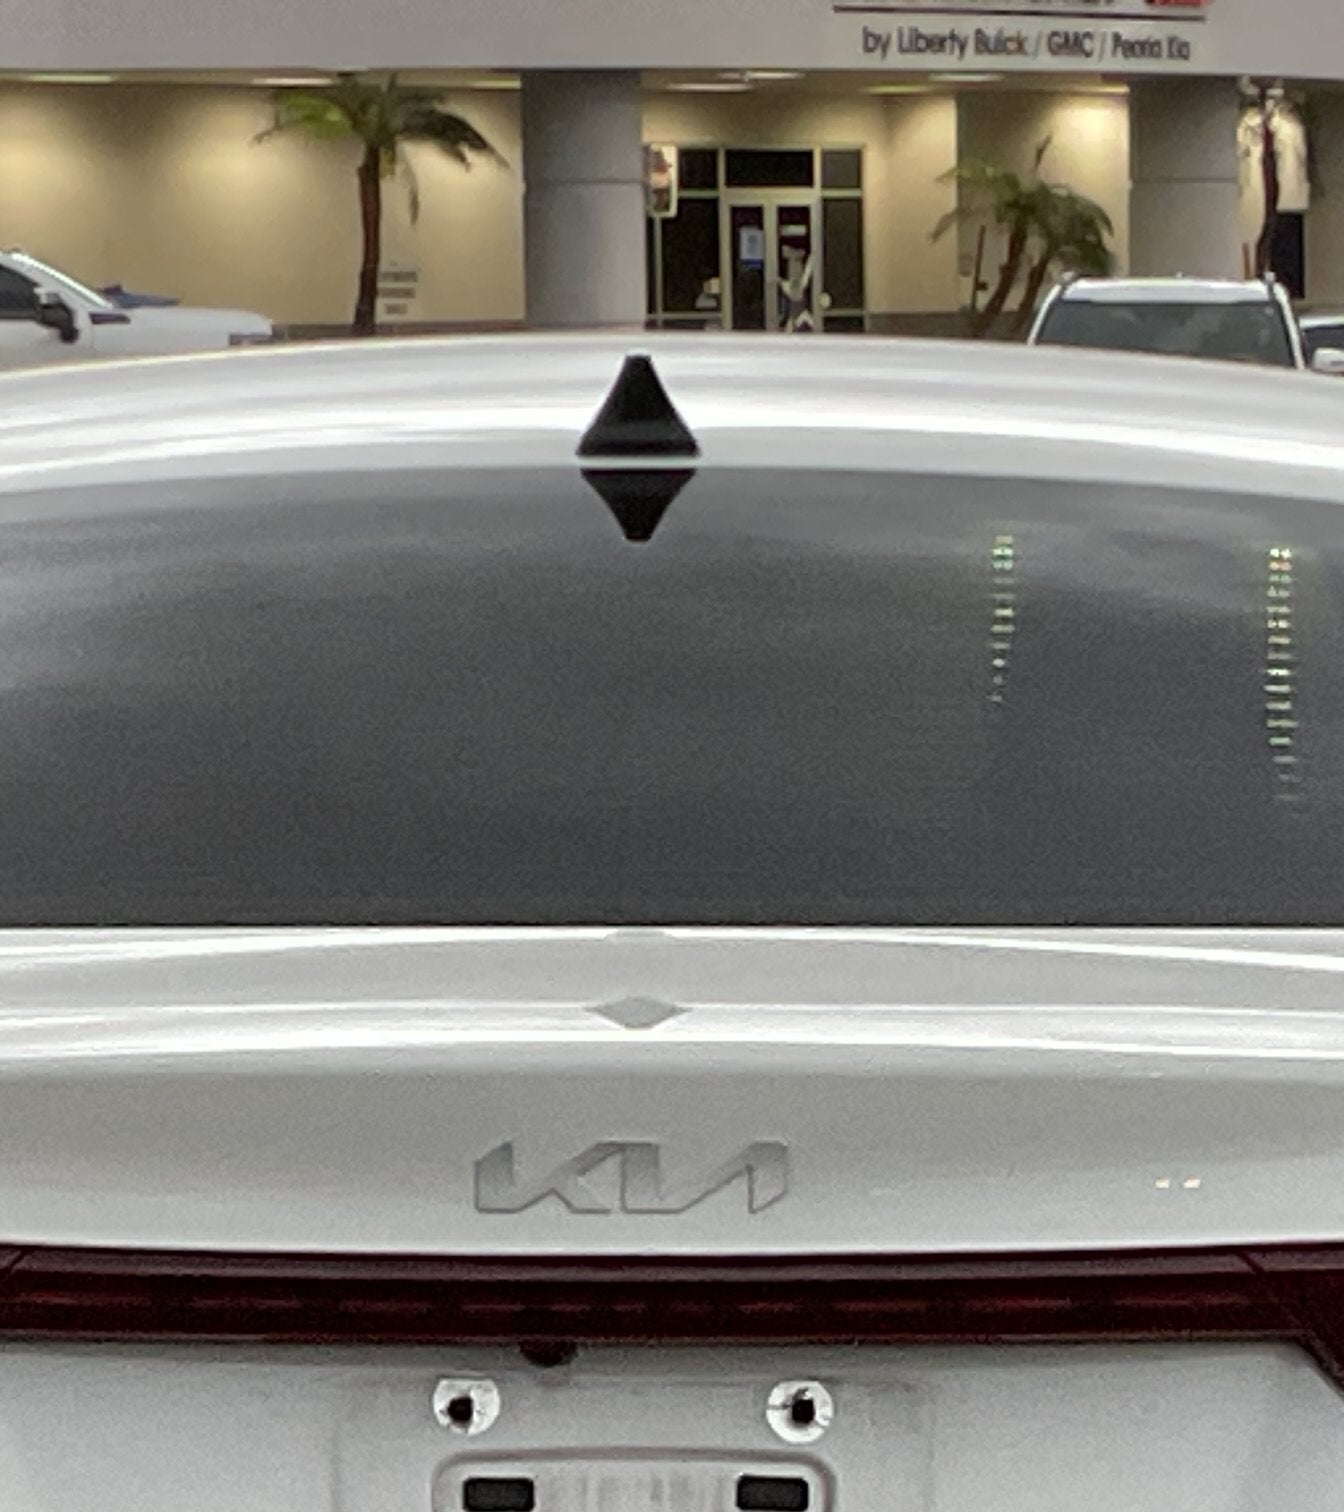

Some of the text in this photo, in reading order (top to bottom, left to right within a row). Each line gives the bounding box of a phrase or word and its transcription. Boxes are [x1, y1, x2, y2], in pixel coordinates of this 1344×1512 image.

[862, 26, 891, 61] by
[897, 26, 969, 60] Liberty
[974, 27, 1027, 57] Buick
[1047, 30, 1094, 58] GMC
[1112, 32, 1162, 59] Peoria
[1167, 36, 1191, 60] Kia
[472, 1140, 789, 1214] KIA
